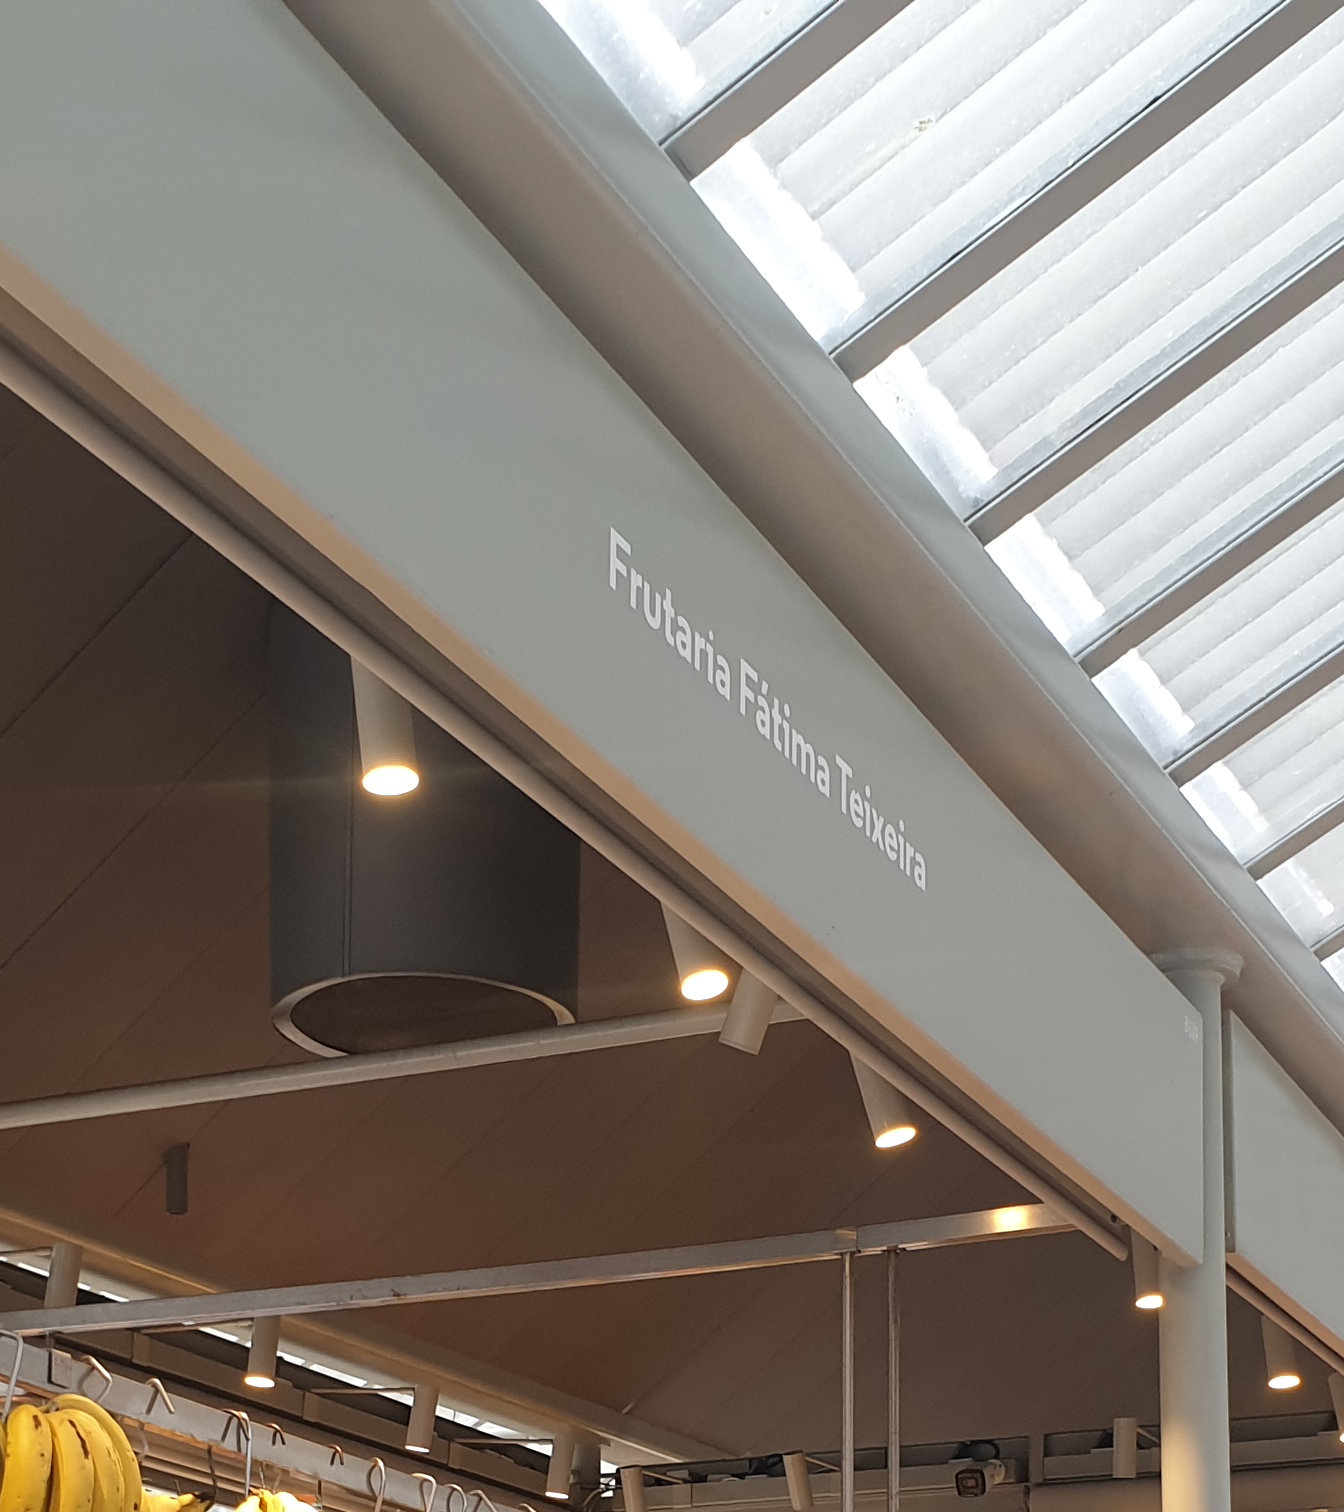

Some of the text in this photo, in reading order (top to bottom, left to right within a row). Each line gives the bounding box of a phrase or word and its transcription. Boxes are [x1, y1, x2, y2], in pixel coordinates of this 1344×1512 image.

[609, 526, 928, 892] Frutaria Fátima Teixeira
